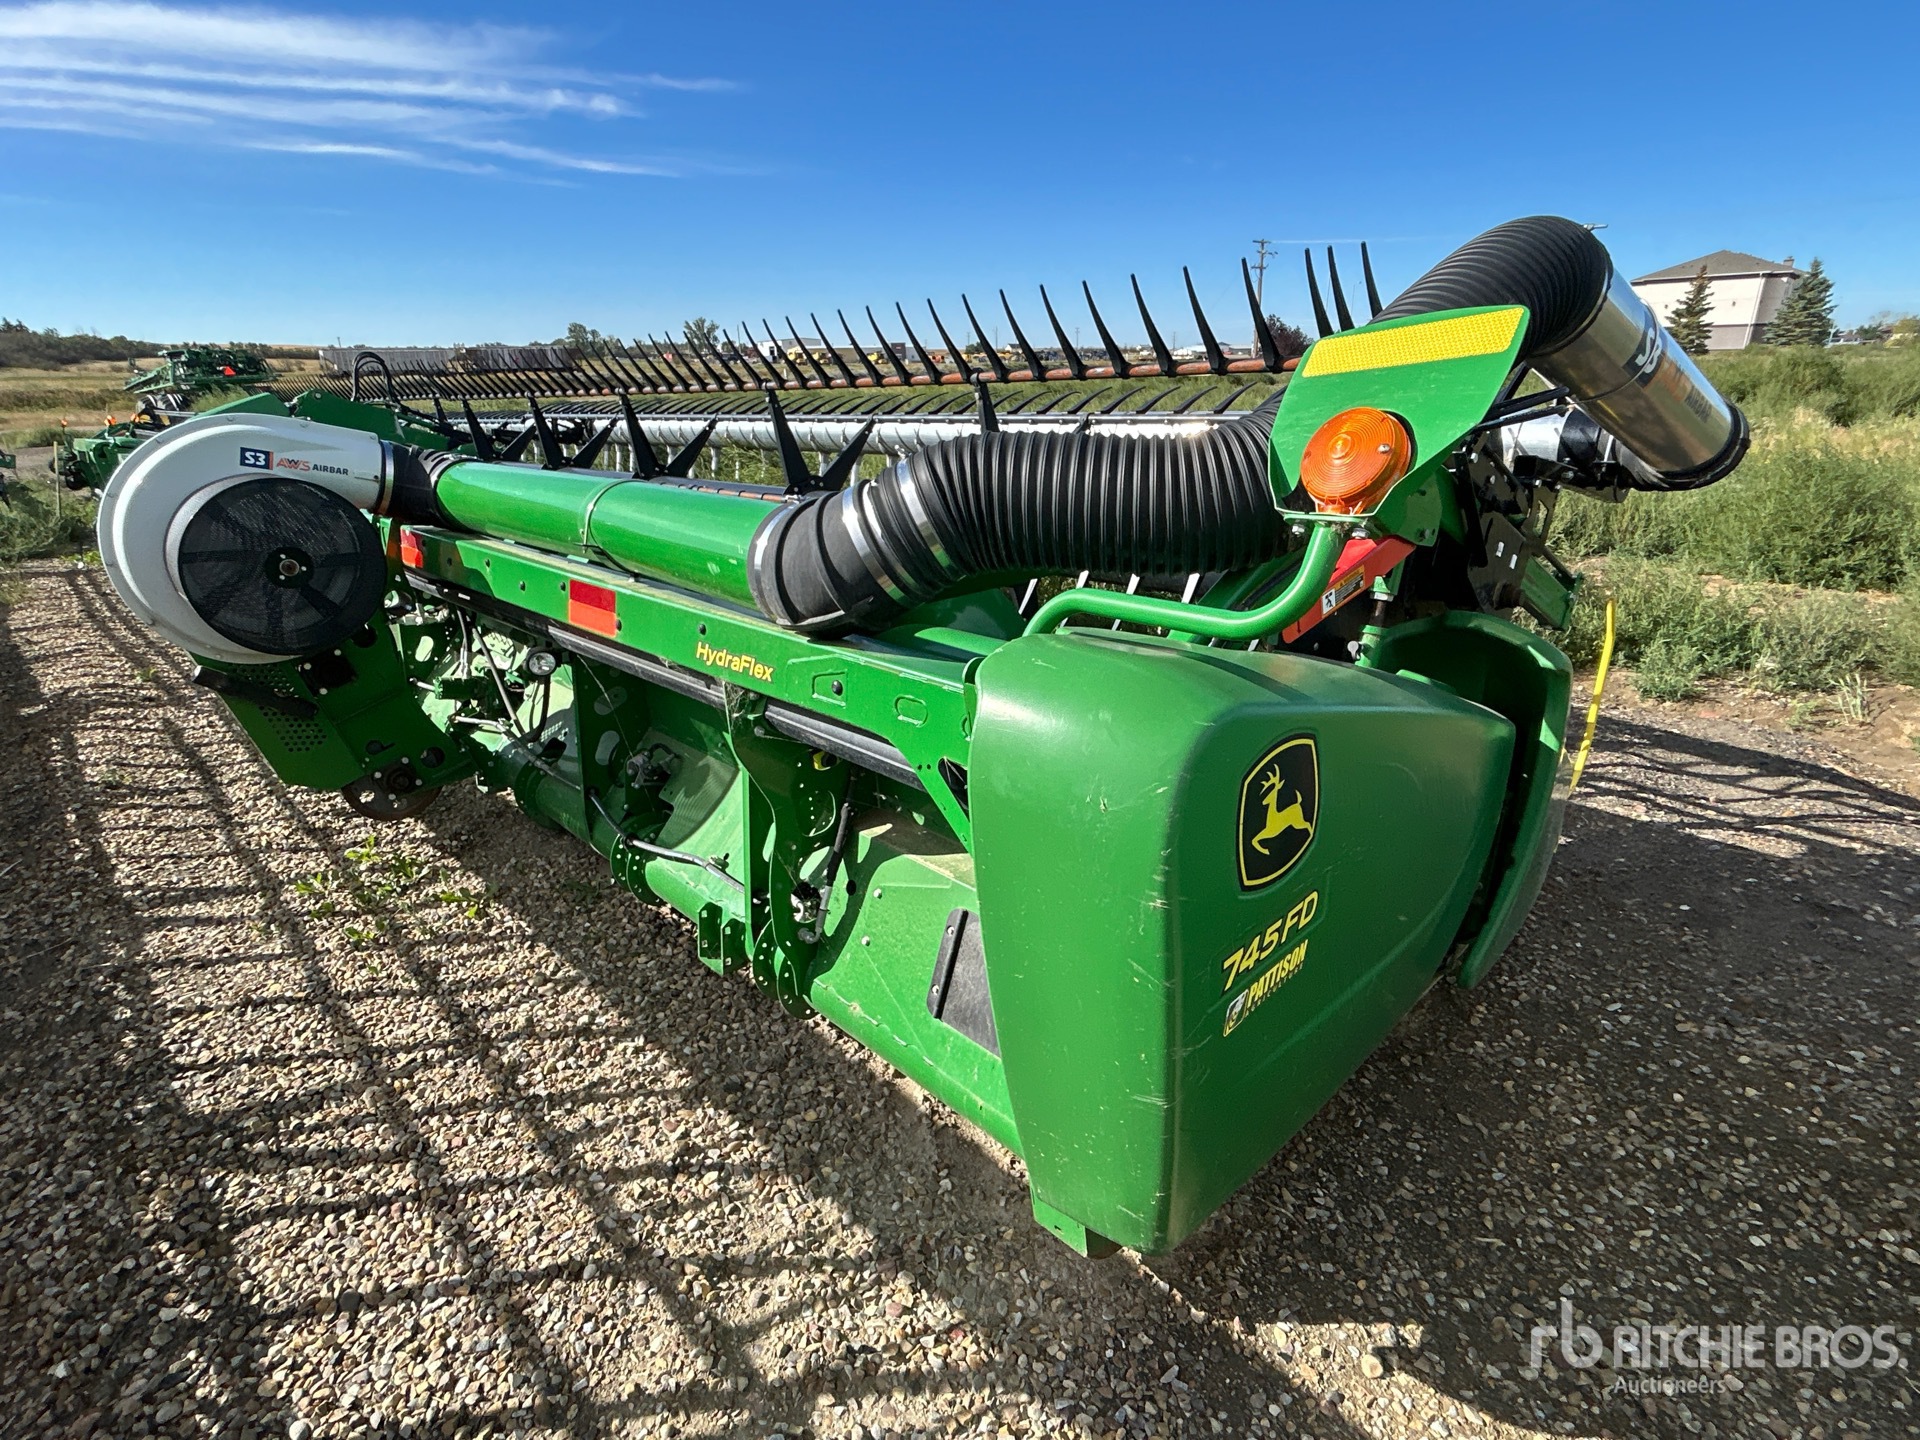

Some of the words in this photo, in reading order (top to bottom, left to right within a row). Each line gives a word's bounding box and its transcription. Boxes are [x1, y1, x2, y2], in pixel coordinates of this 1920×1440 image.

[244, 451, 266, 466] S3
[276, 457, 311, 472] AWS
[312, 463, 349, 476] AIRBAR
[696, 641, 774, 682] HydraFlex
[1247, 938, 1309, 1009] PATTISON
